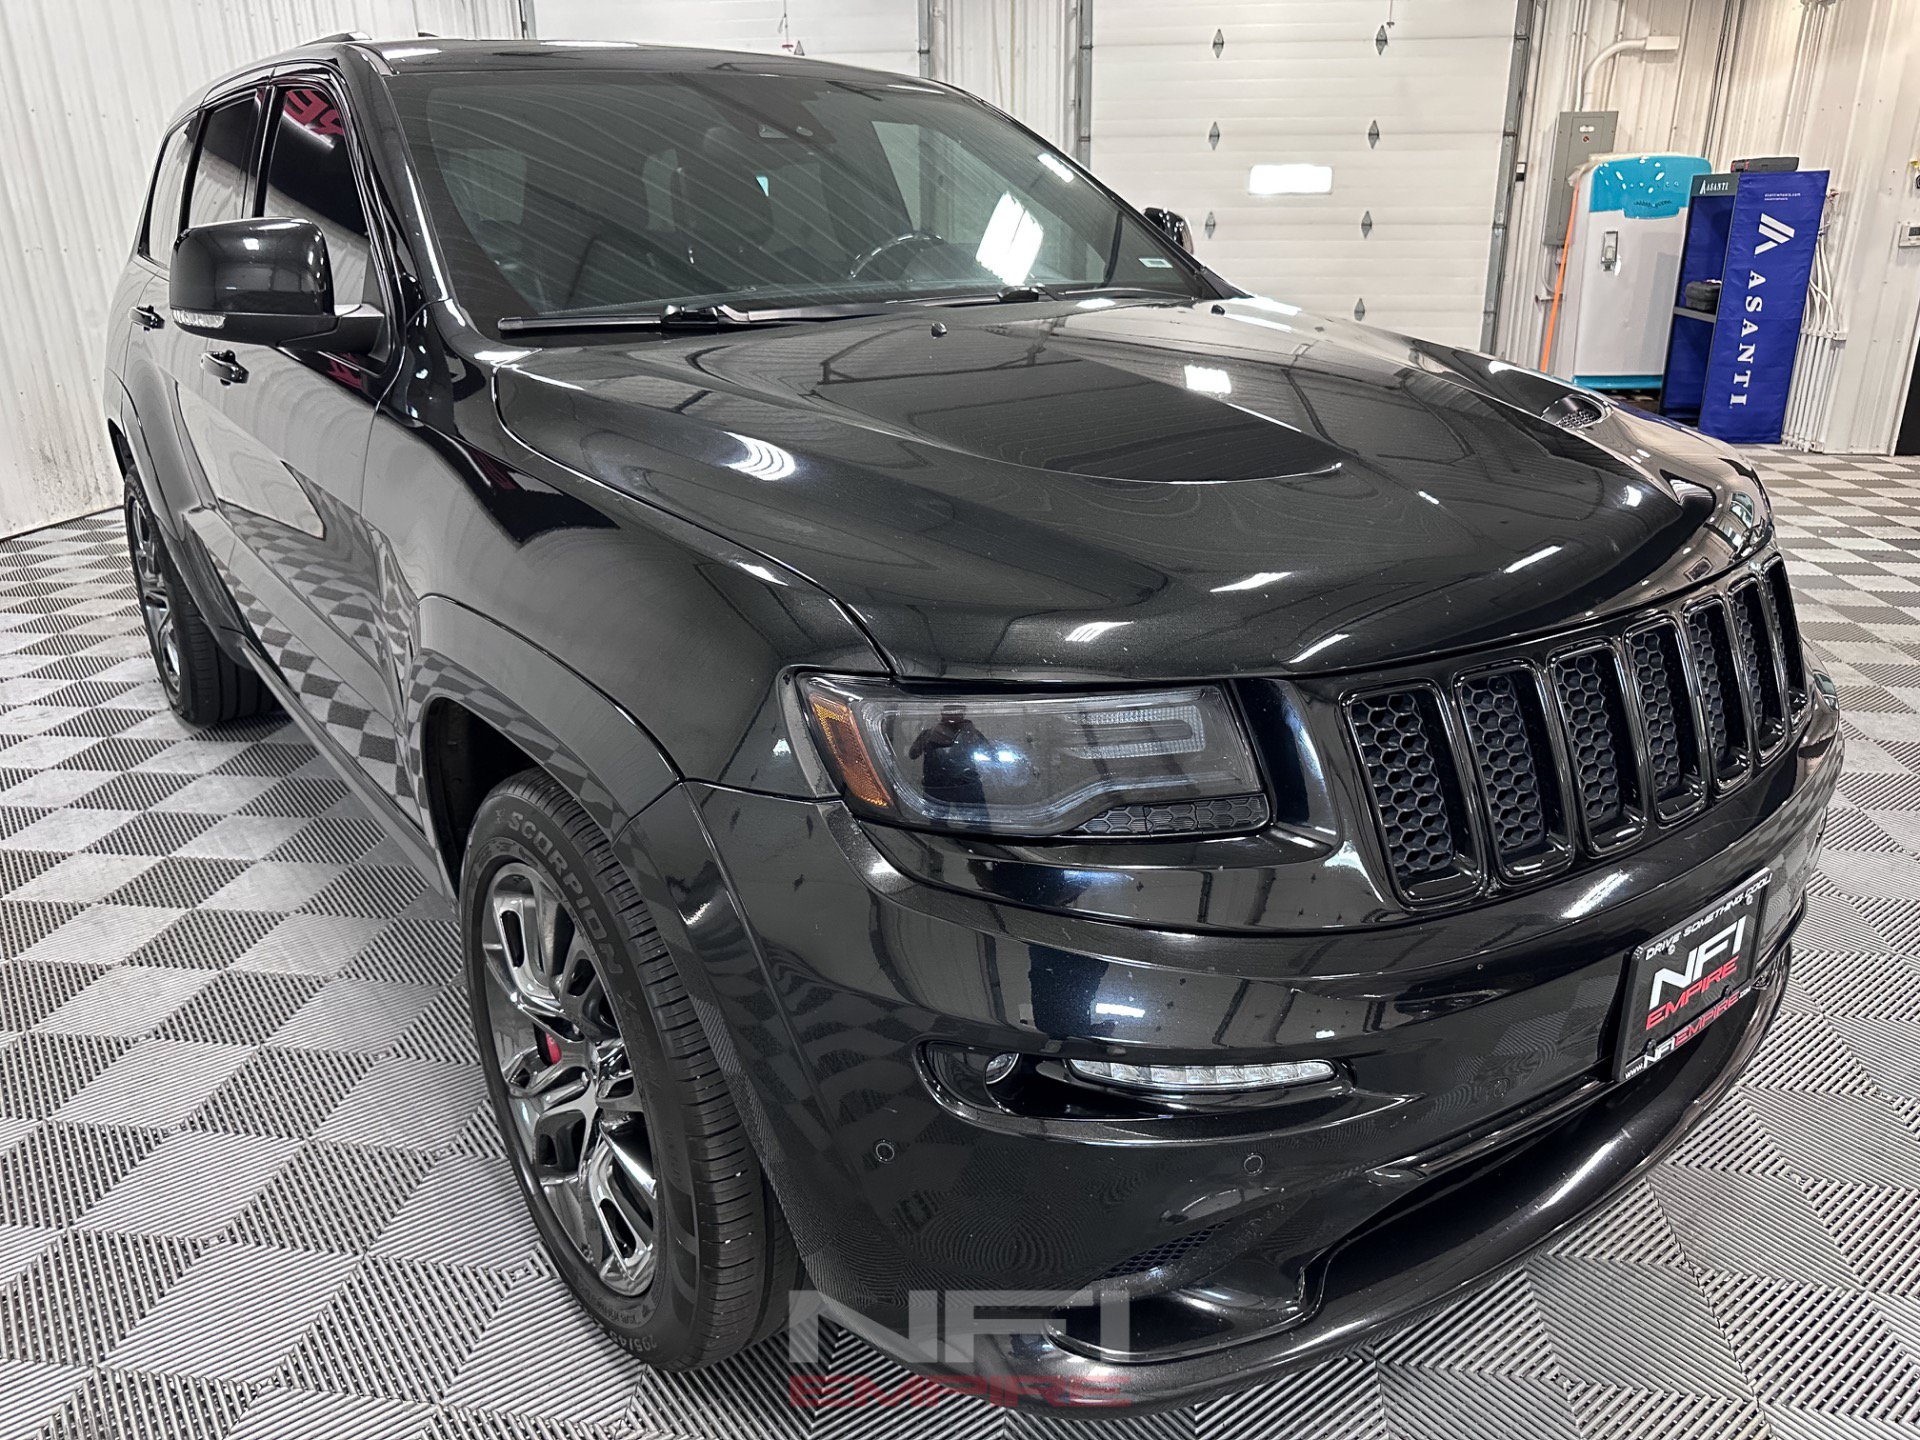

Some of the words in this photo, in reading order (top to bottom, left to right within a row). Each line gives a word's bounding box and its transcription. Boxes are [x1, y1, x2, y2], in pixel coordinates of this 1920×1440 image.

[1729, 270, 1767, 407] ASANTI
[508, 811, 624, 974] SCORPION
[1645, 931, 1682, 961] DRIVE
[1682, 892, 1745, 938] SOMETHING
[1645, 954, 1740, 1031] EMPIRE
[1649, 915, 1747, 1010] NFI
